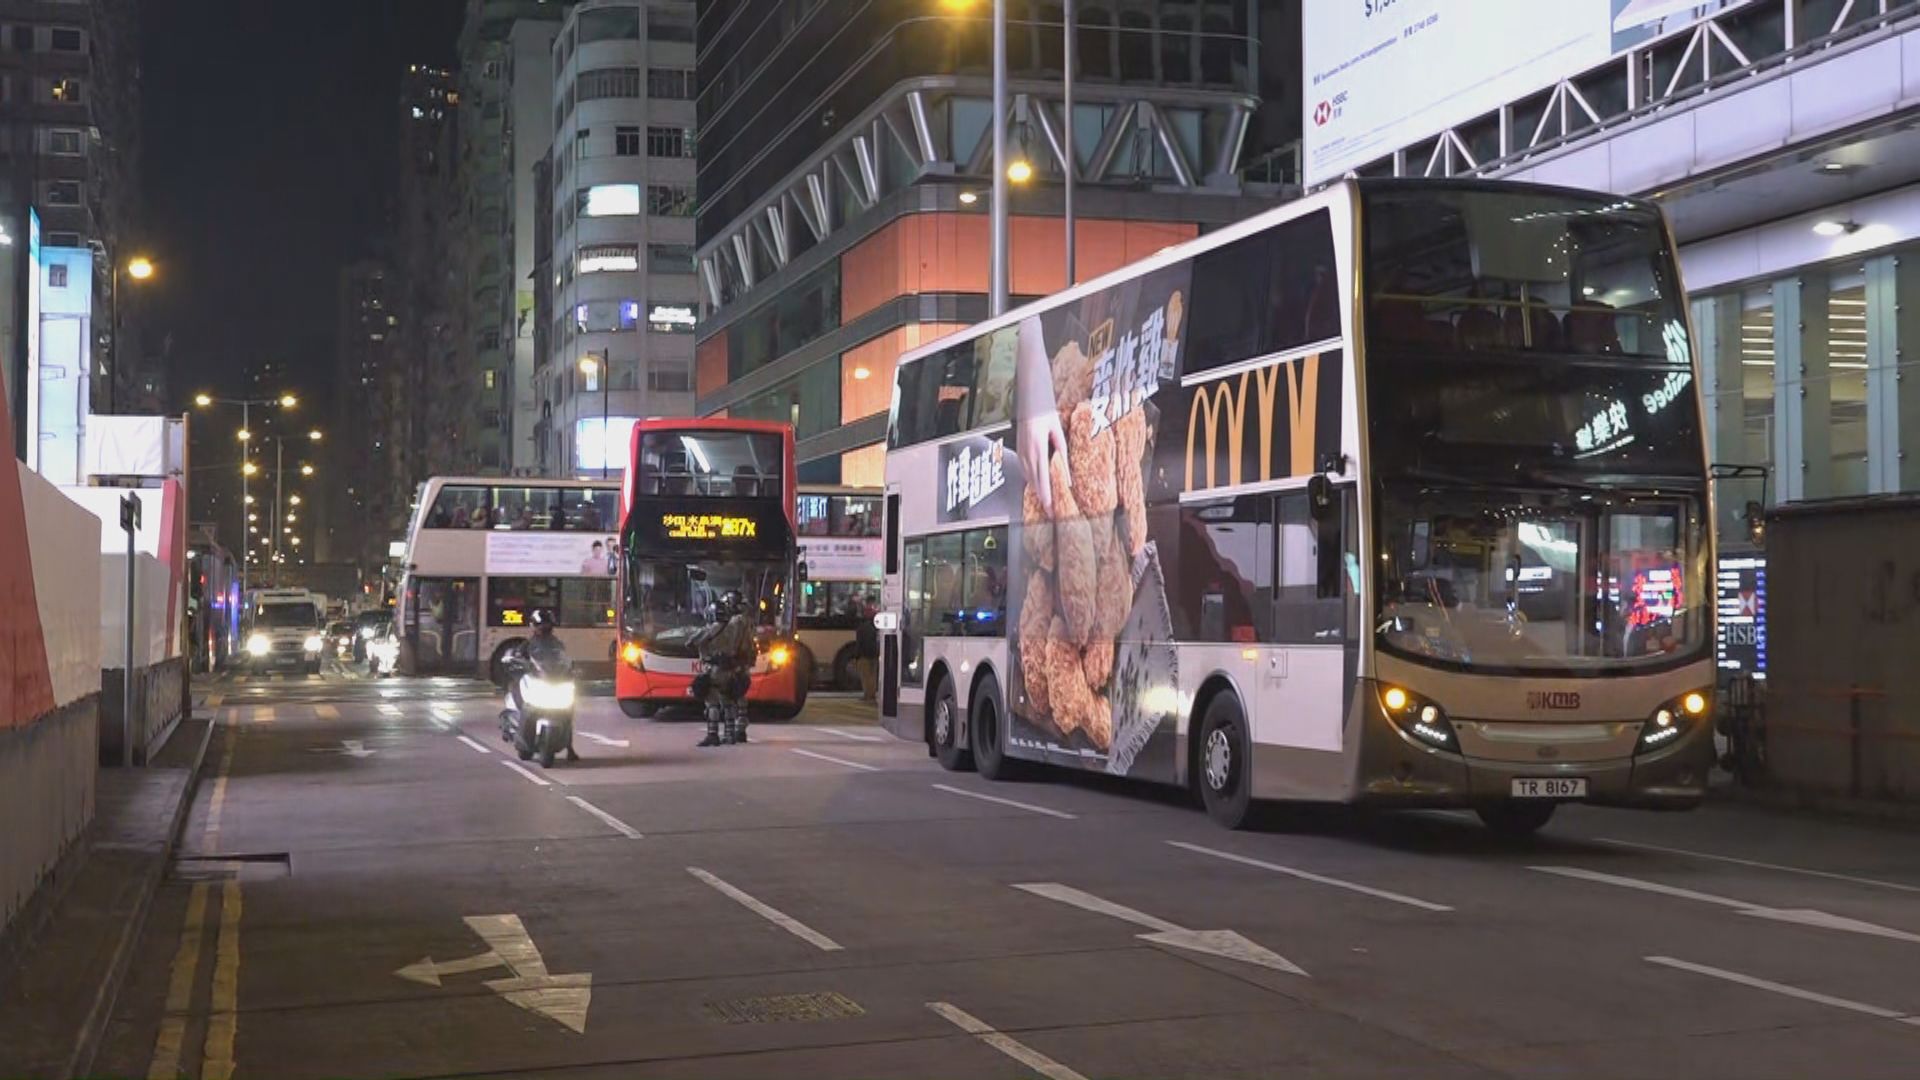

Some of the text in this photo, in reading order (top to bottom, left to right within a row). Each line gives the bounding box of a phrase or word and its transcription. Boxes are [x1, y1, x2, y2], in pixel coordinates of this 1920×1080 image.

[1090, 324, 1109, 358] NEW
[1519, 780, 1578, 794] TR 8167
